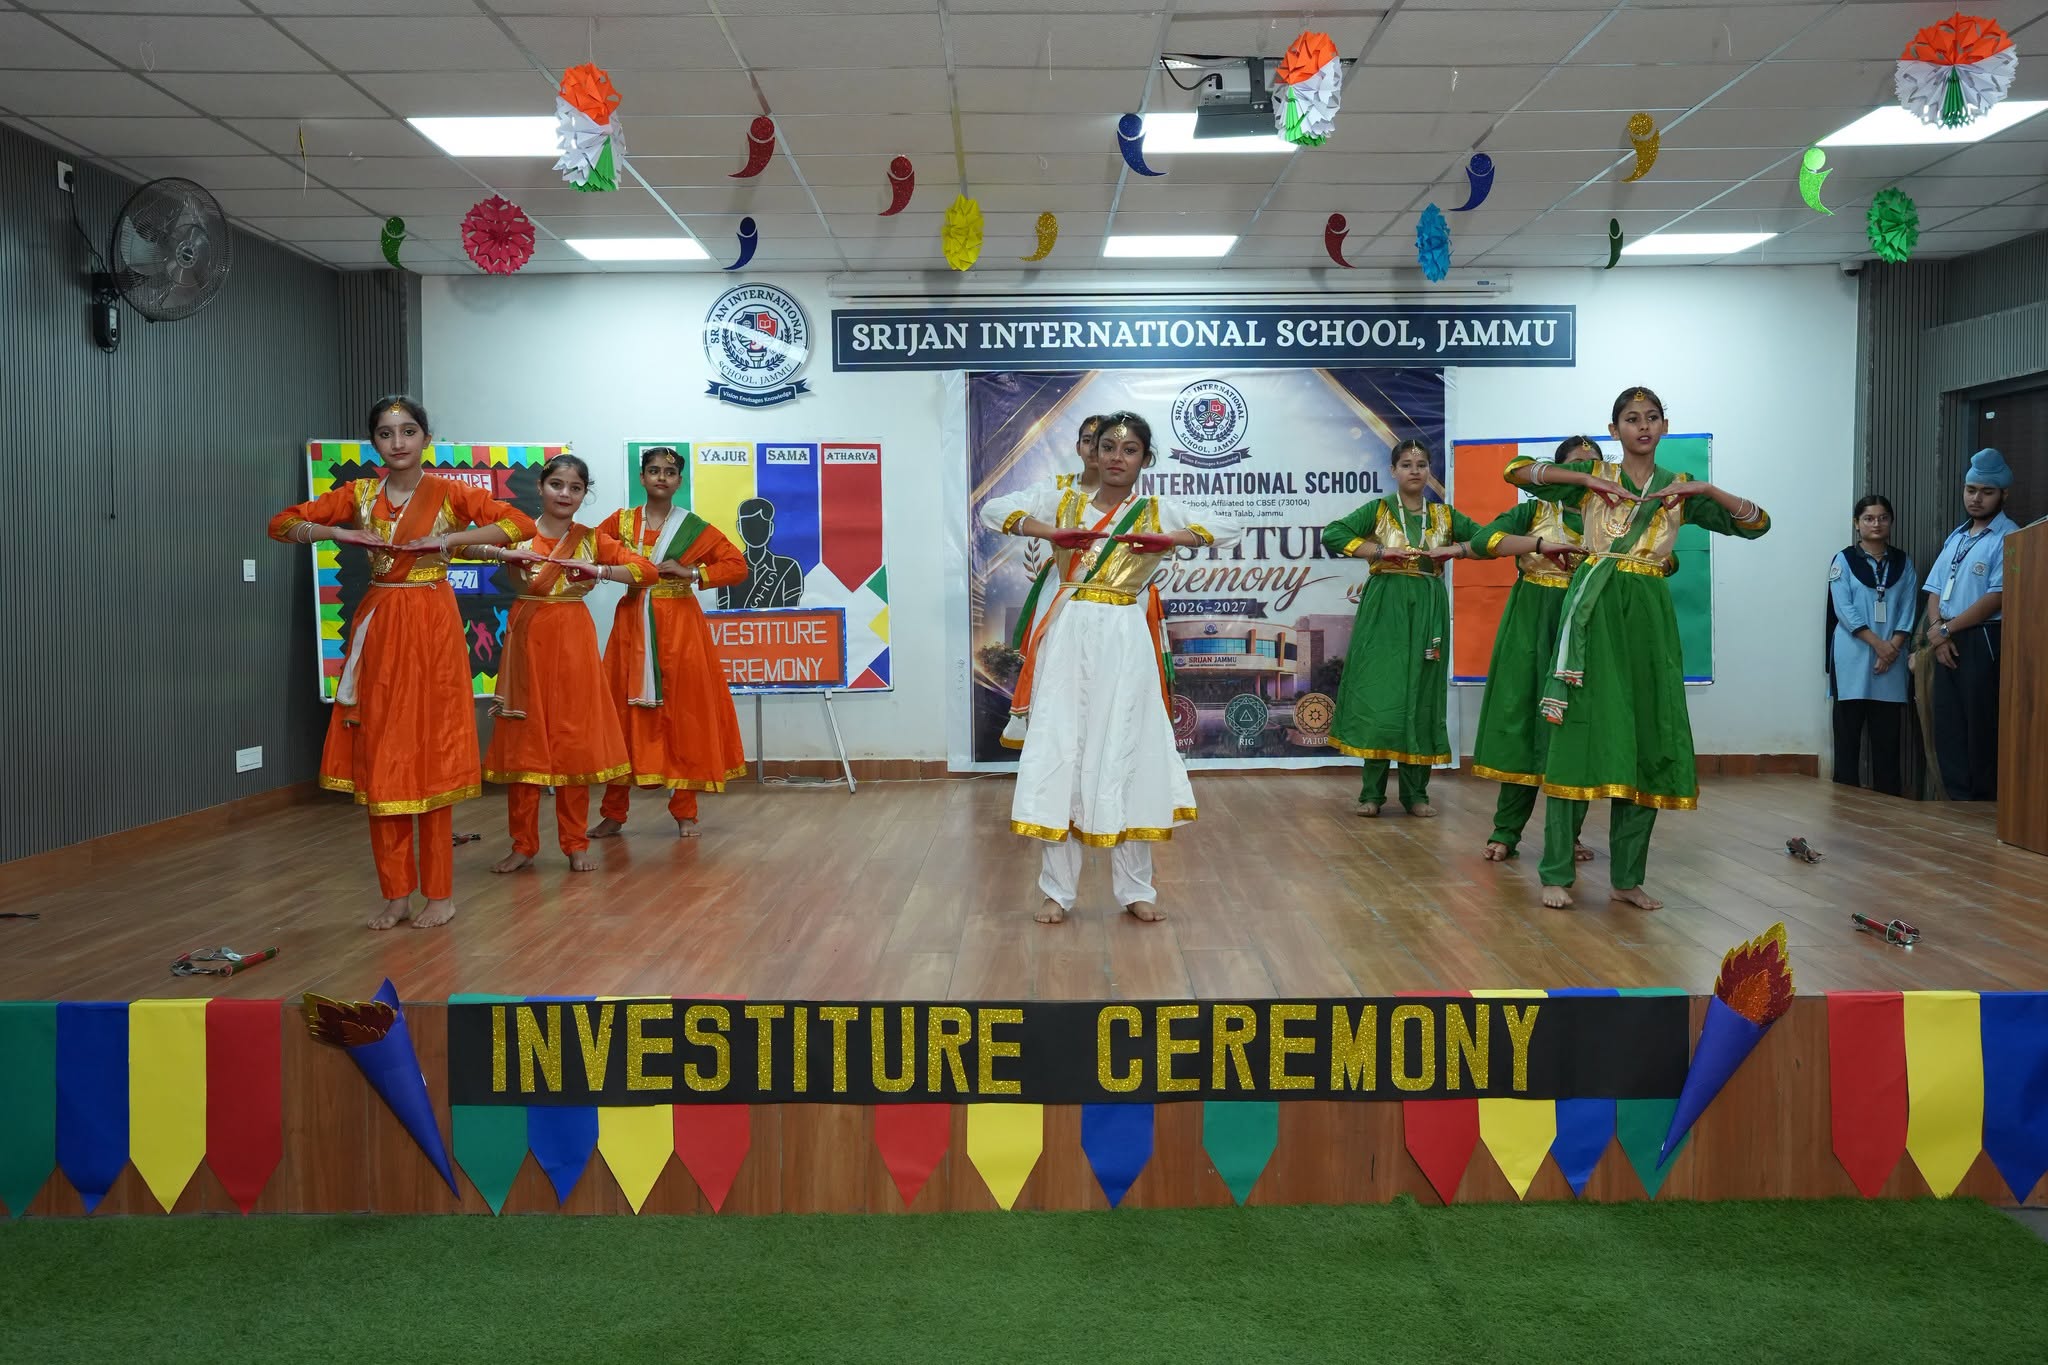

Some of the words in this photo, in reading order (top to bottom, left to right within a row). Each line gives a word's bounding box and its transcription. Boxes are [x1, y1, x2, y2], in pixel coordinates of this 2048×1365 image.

[728, 289, 803, 343] INTERNATIONAL
[852, 323, 968, 356] SRIJAN
[980, 320, 1266, 349] INTERNATIONAL
[1276, 319, 1426, 350] SCHOOL,
[1436, 319, 1558, 353] JAMMU
[760, 364, 793, 385] JAMMU
[722, 391, 739, 400] Vision
[764, 391, 792, 402] Knowledge
[1193, 383, 1244, 420] INTERNATIONAL
[1180, 432, 1210, 454] SCHOOL,
[1213, 433, 1239, 453] JAMMU
[701, 449, 746, 462] YAJUR
[767, 447, 808, 461] SAMA
[826, 451, 876, 461] ATHARVA
[1305, 471, 1383, 494] SCHOOL
[1211, 499, 1244, 507] Affiliated
[1256, 498, 1276, 506] CBSE
[1278, 498, 1310, 507] (730104)
[1257, 509, 1284, 517] Jammu
[1136, 562, 1344, 612] eremony
[709, 620, 828, 646] VESTITURE
[719, 656, 823, 683] REMONY
[1188, 656, 1212, 664] SRIJAN
[1239, 738, 1254, 746] RIG
[491, 1003, 1024, 1095] INVESTITURE
[1097, 1003, 1541, 1093] CEREMONY
